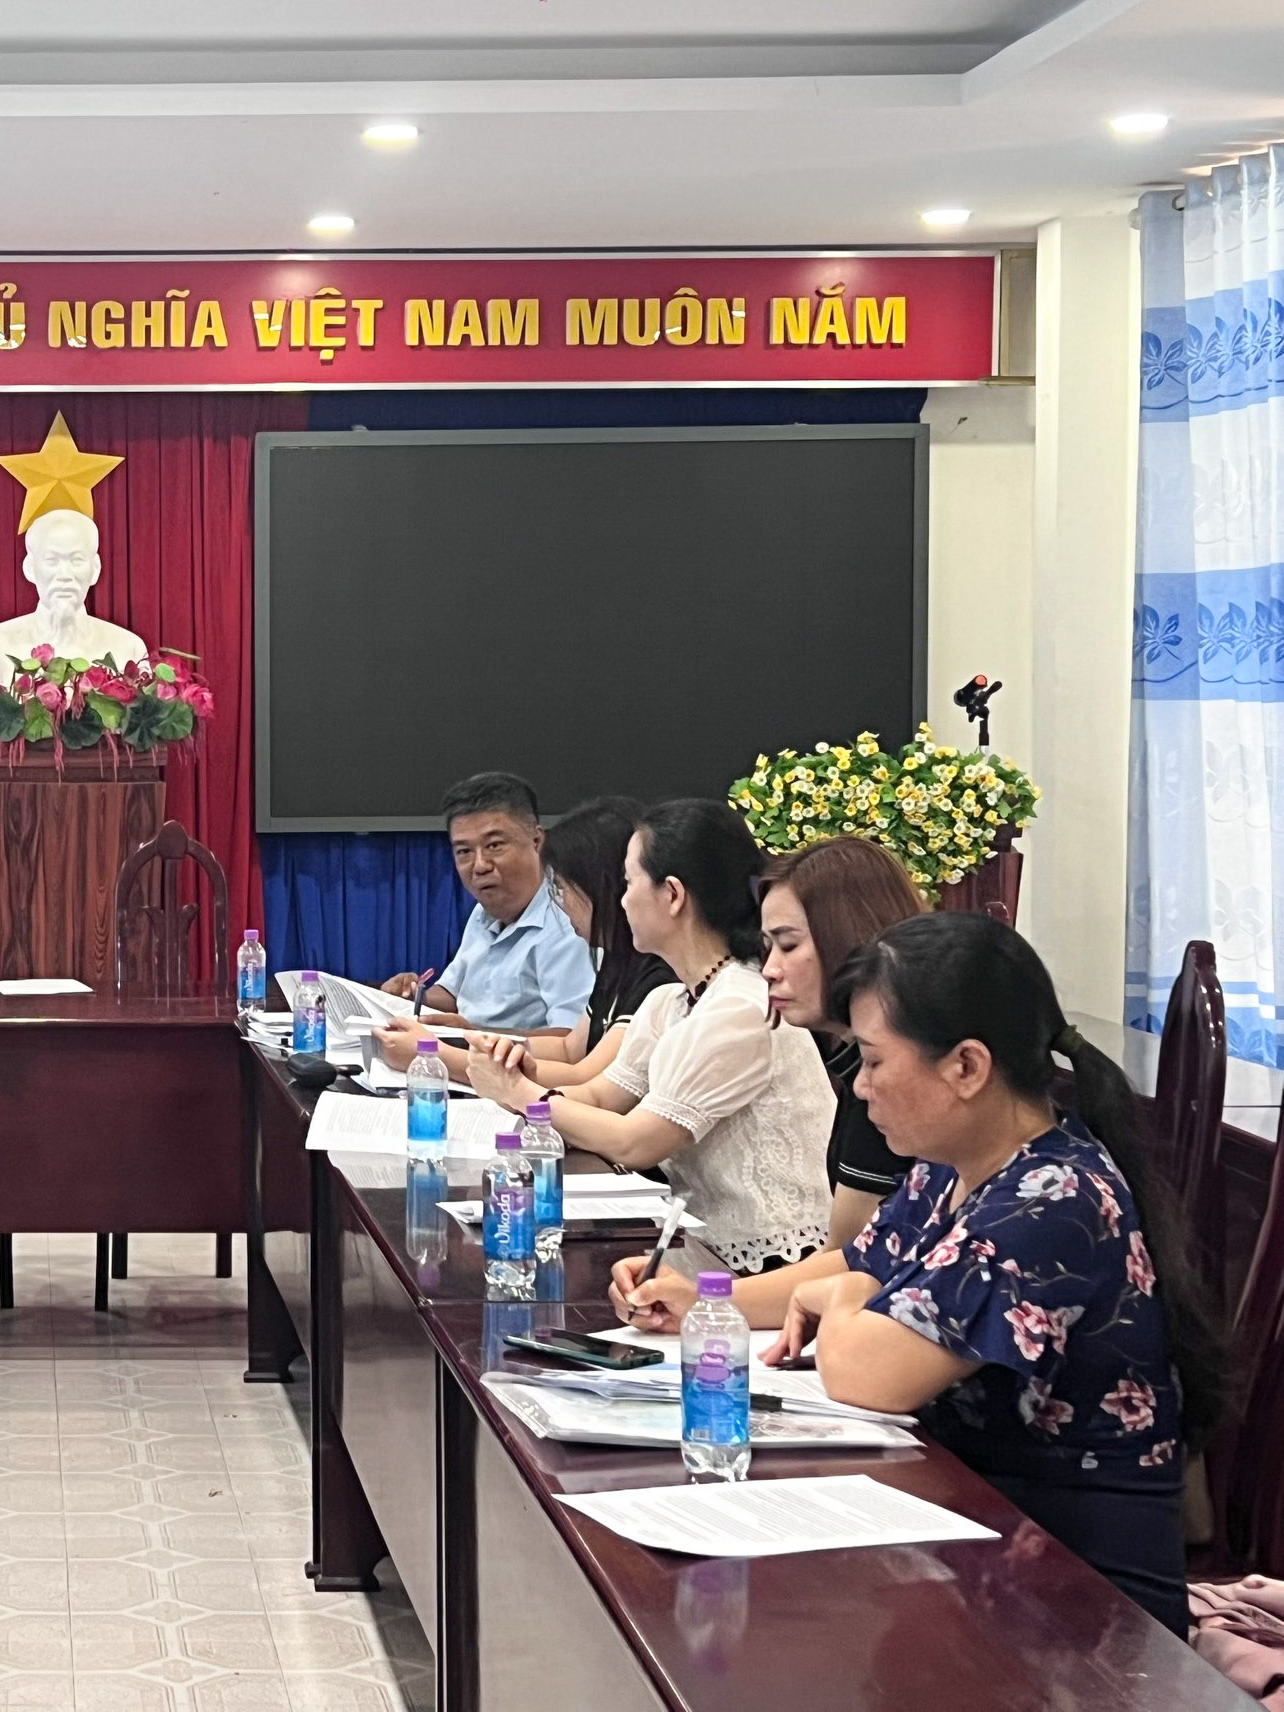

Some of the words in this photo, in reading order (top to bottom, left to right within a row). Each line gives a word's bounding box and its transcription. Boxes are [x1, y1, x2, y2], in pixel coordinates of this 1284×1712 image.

[48, 288, 229, 348] NGHĨA
[252, 287, 384, 360] VIỆT
[404, 298, 539, 347] NAM
[566, 287, 746, 347] MUÔN
[769, 282, 906, 345] NĂM
